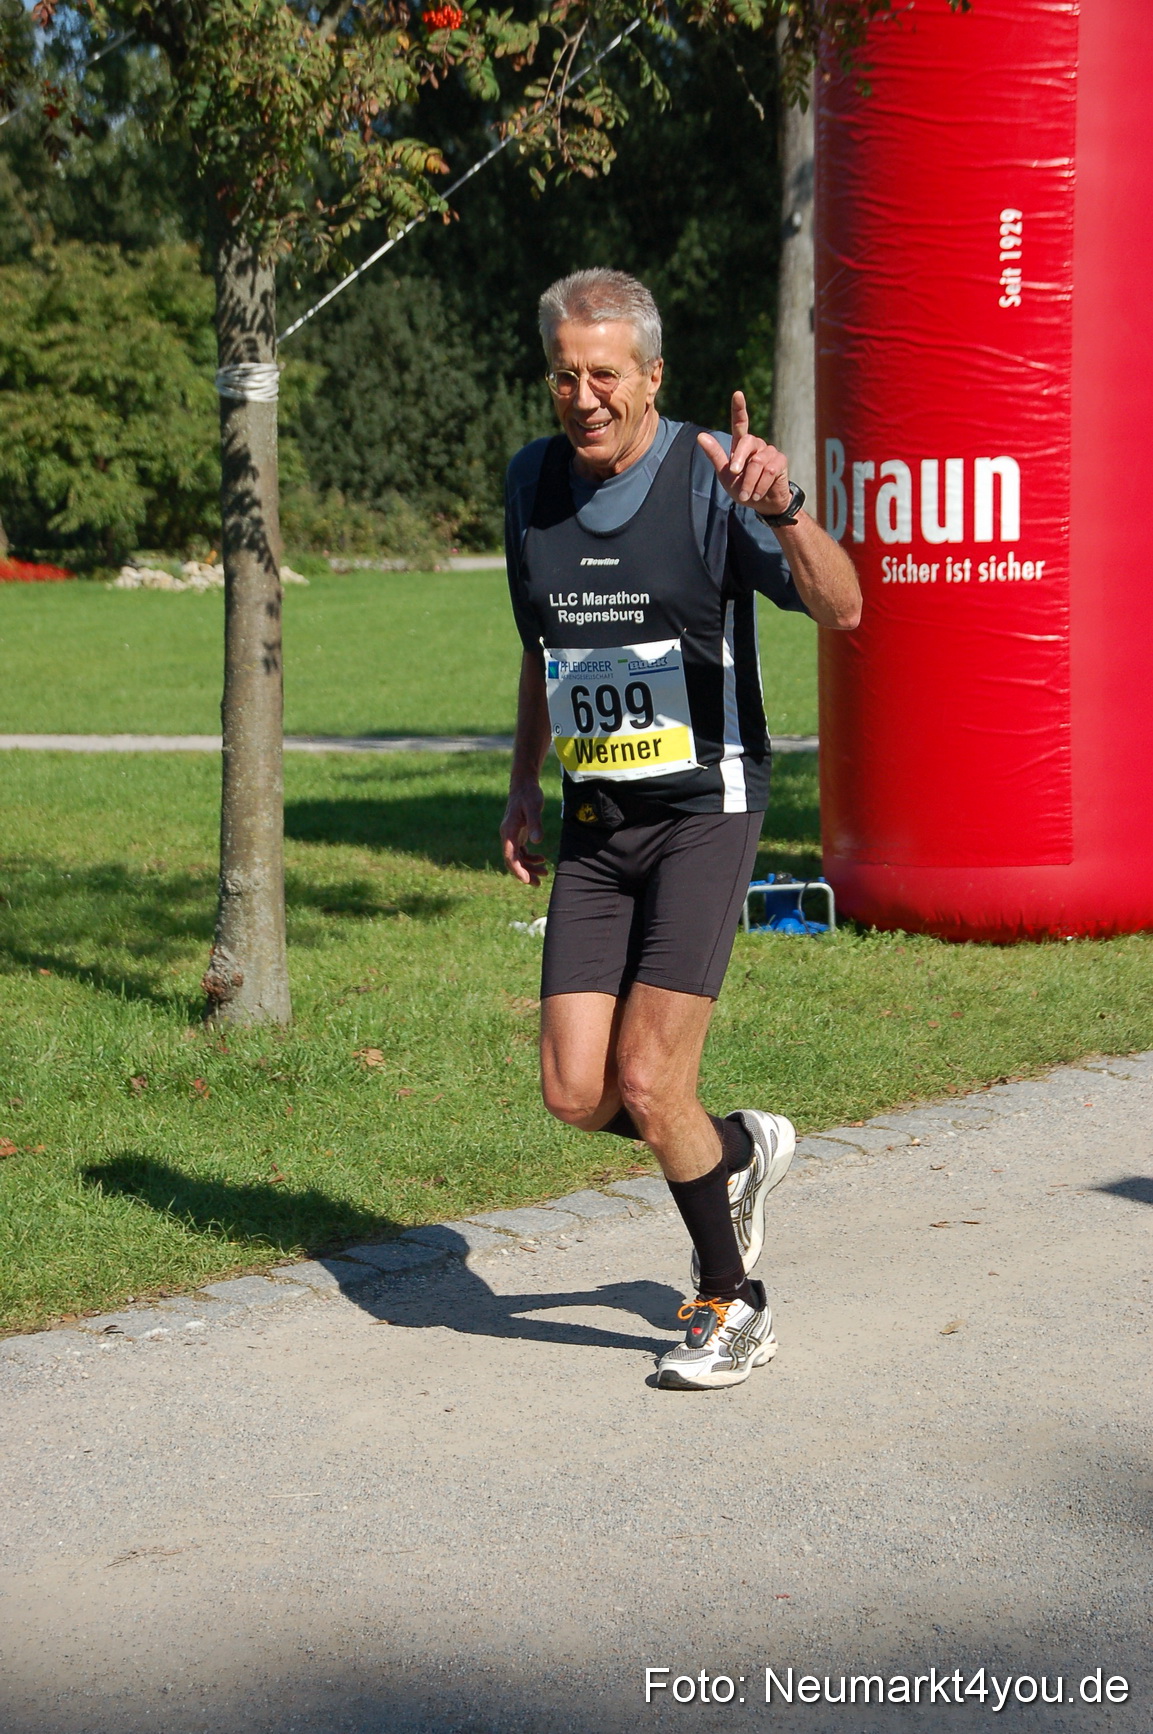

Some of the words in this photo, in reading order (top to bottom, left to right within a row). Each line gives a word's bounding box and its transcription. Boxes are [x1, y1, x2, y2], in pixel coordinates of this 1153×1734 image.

[999, 208, 1023, 262] 1929
[999, 268, 1022, 308] Seit
[825, 437, 1021, 545] Braun
[881, 553, 940, 584] Sicher
[945, 556, 972, 583] ist
[978, 551, 1046, 582] sicher
[549, 593, 578, 607] LLC
[582, 591, 650, 606] Marathon
[558, 608, 644, 626] Regensburg
[560, 660, 613, 673] PFLEIDERER
[570, 681, 654, 734] 699
[574, 737, 662, 764] Werner
